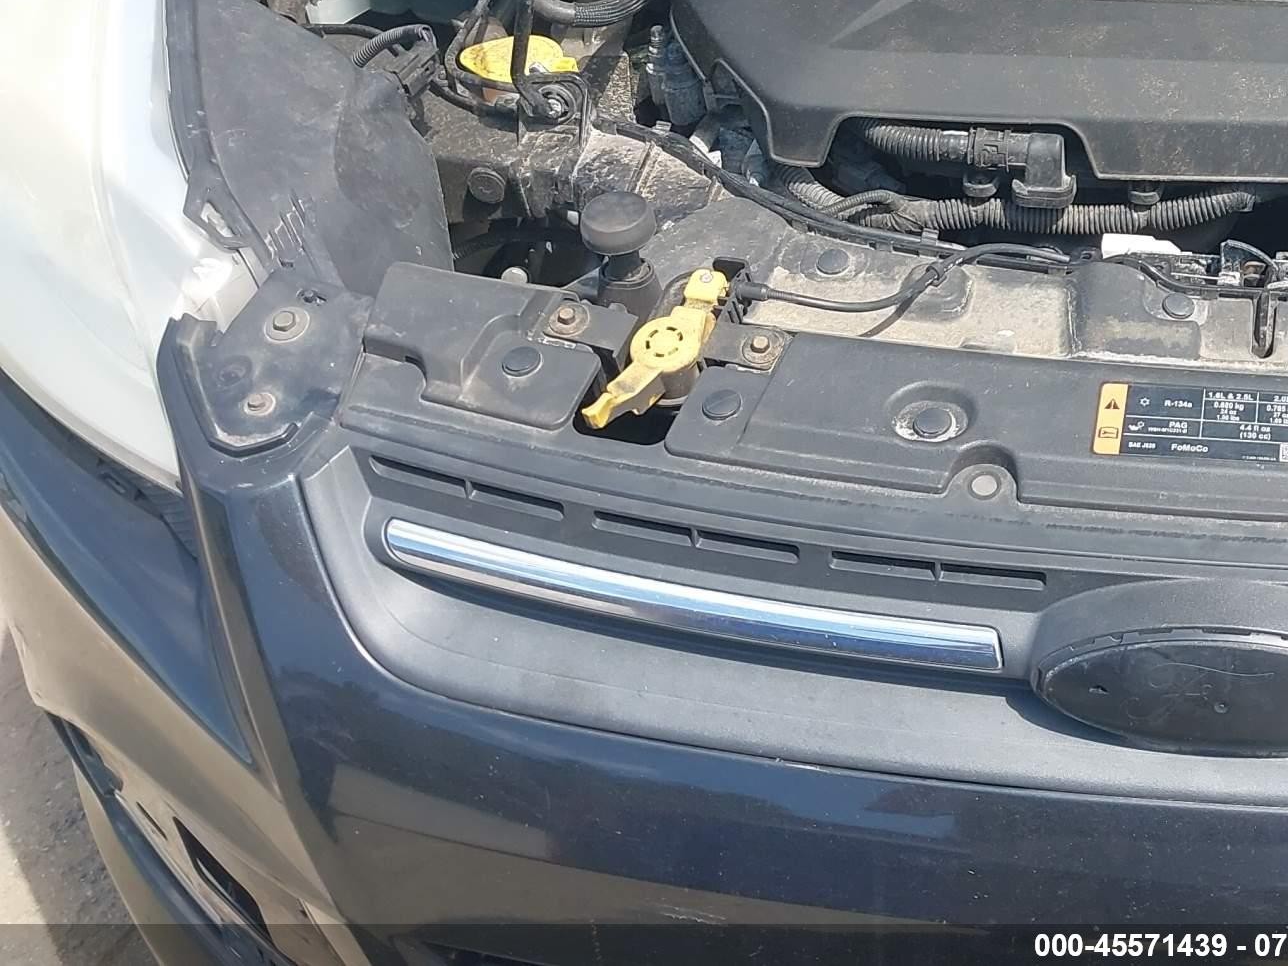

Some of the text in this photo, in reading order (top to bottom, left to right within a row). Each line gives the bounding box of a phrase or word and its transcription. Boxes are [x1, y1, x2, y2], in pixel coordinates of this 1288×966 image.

[1164, 399, 1193, 409] R-134a
[1169, 421, 1188, 429] PAG
[1239, 431, 1271, 441] (130 cc)
[1171, 443, 1209, 453] FoMoCo
